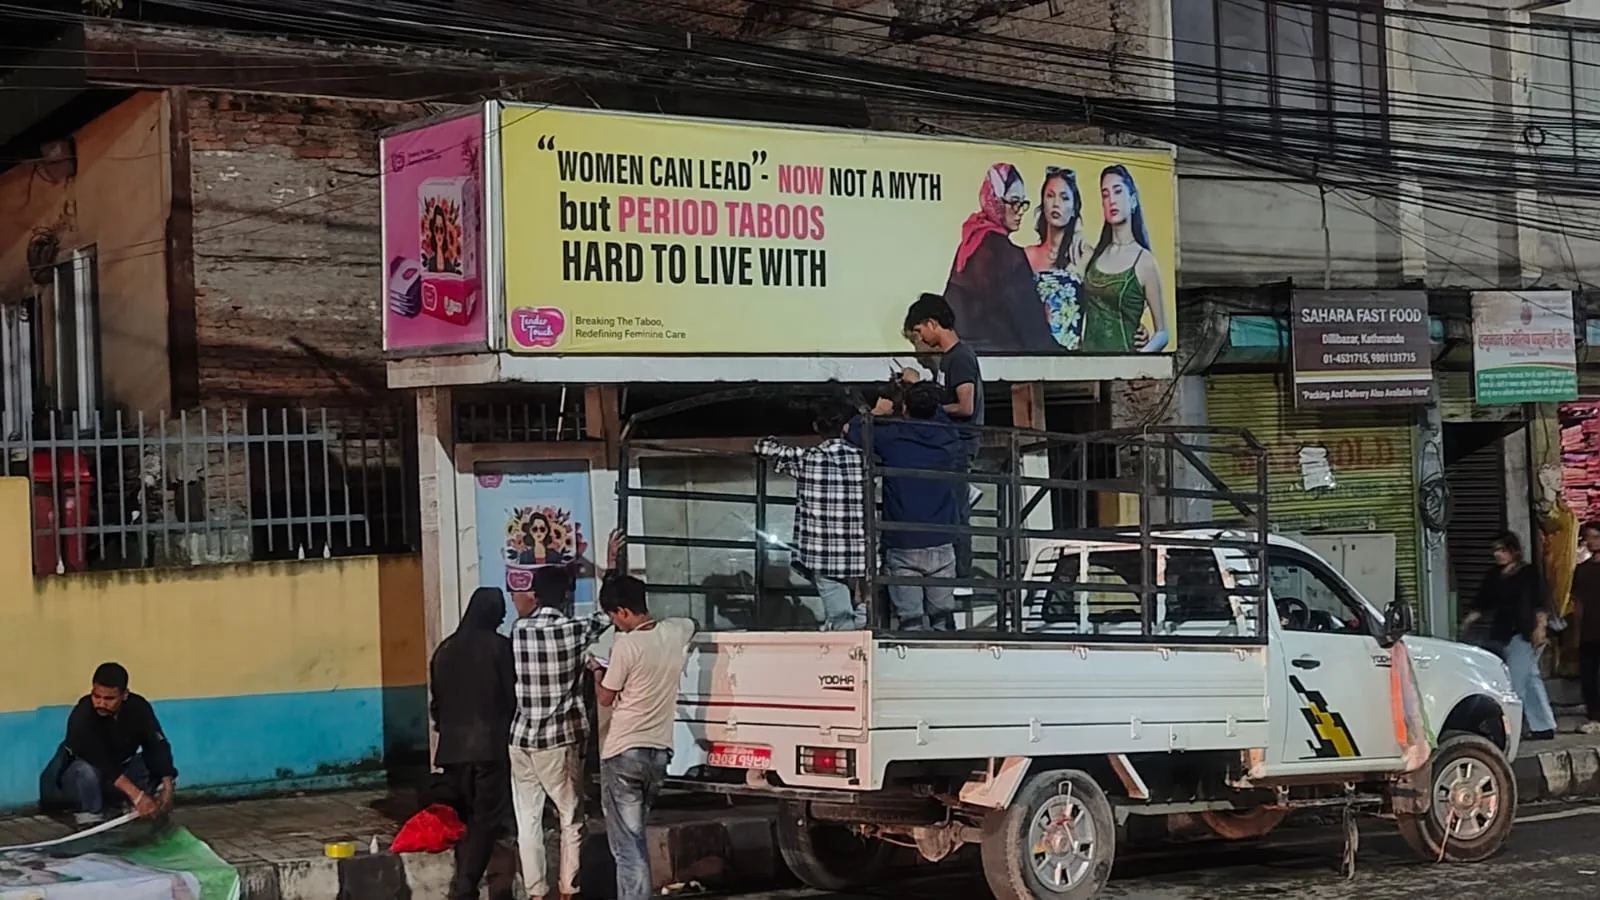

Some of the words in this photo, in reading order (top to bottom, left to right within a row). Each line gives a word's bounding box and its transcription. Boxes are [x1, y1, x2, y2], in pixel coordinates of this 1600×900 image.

[650, 156, 693, 188] CAN
[778, 164, 824, 195] NOW
[829, 168, 867, 197] NOT
[871, 170, 884, 198] A
[889, 171, 941, 201] MYTH
[560, 191, 610, 232] but
[618, 196, 718, 236] PERIOD
[725, 201, 825, 240] TABOOS
[562, 240, 643, 282] HARD
[651, 244, 686, 284] TO
[695, 245, 753, 285] LIVE
[759, 247, 827, 287] WITH
[519, 314, 549, 332] Tender
[575, 316, 615, 328] Breaking
[617, 316, 633, 326] The
[634, 317, 664, 327] Taboo,
[1301, 308, 1355, 323] SAHARA
[1357, 308, 1386, 322] FAST
[1389, 308, 1422, 322] FOOD
[527, 325, 554, 342] Touch
[575, 329, 623, 340] Redefining
[625, 329, 663, 339] Feminine
[665, 330, 686, 339] Care
